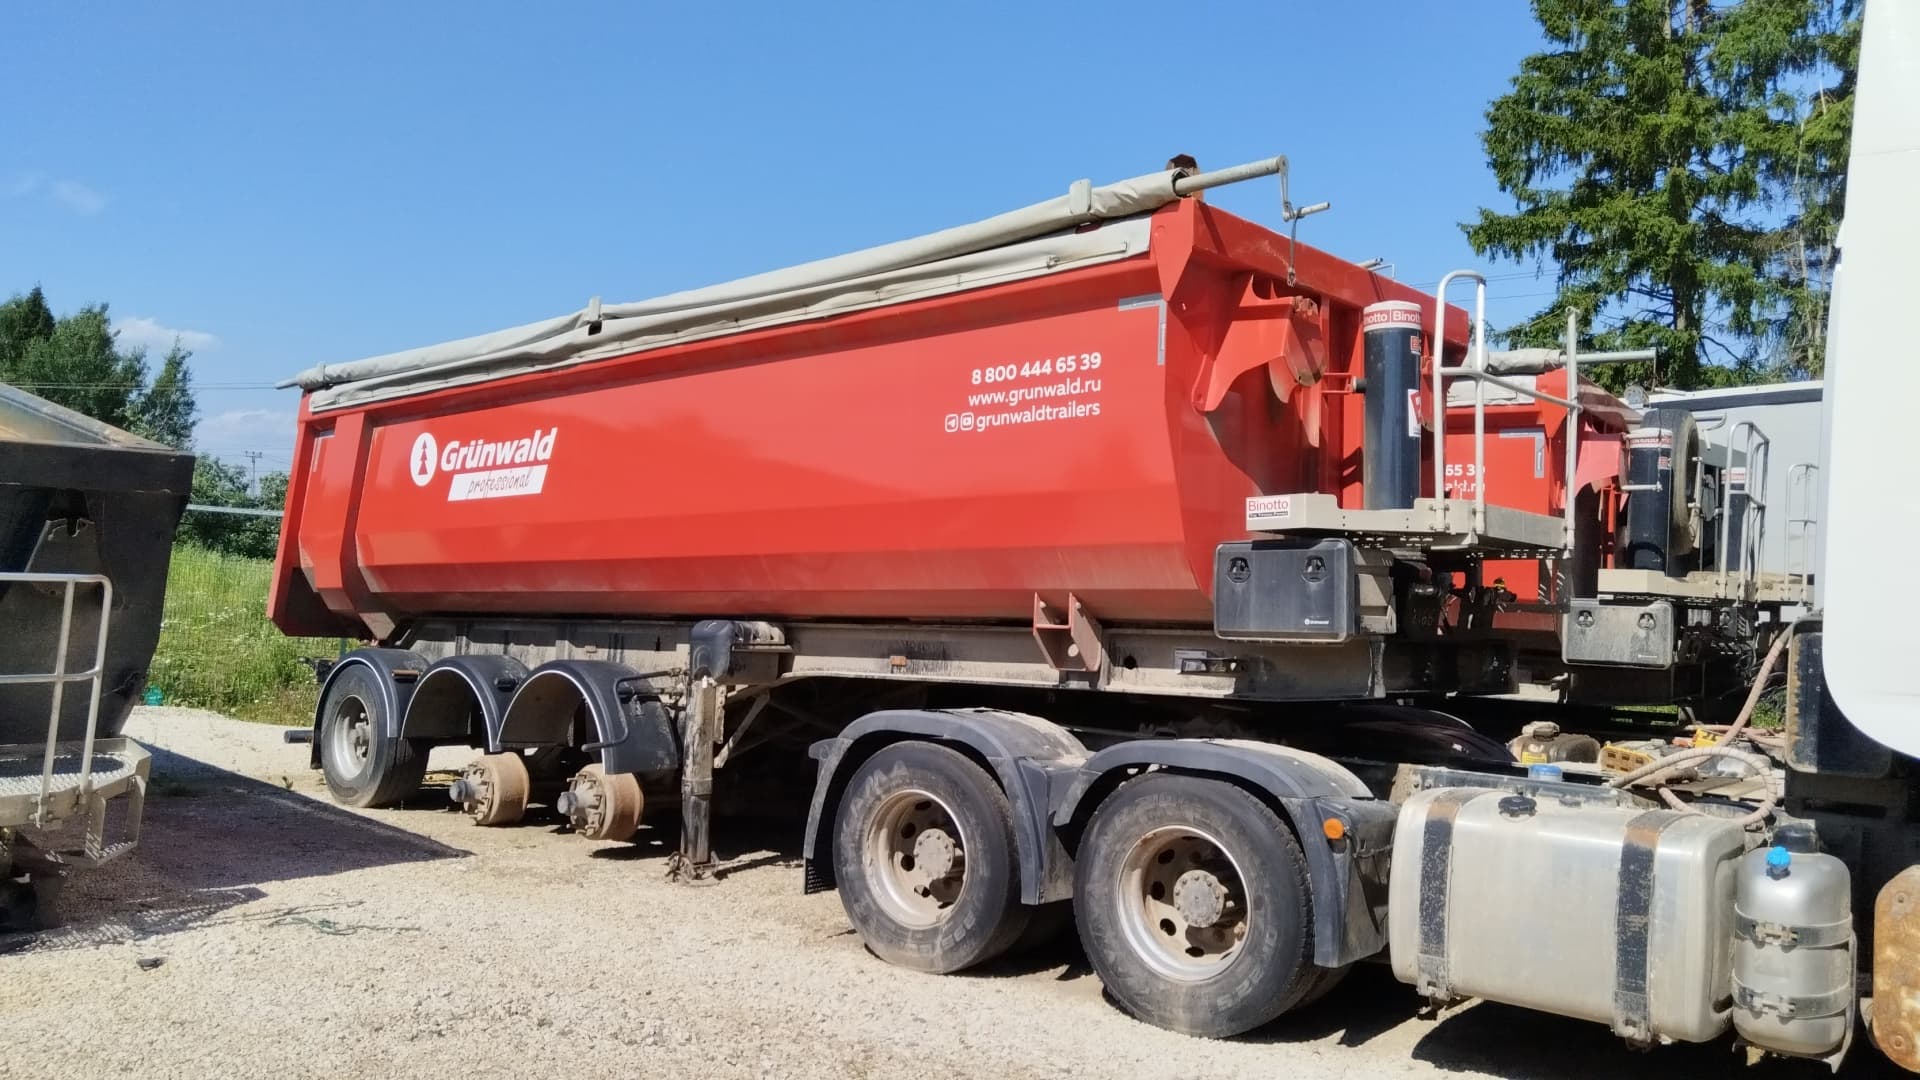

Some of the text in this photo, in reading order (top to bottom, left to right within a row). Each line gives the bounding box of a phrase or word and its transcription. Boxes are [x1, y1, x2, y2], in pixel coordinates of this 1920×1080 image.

[971, 352, 1101, 384] 8 800 444 65 39
[968, 377, 1101, 407] www.grunwald.ru
[976, 400, 1101, 432] grunwaldtrailers
[441, 427, 558, 471] Grünwald
[467, 466, 534, 499] professional
[1466, 464, 1485, 477] 3
[1249, 500, 1289, 511] Binotto
